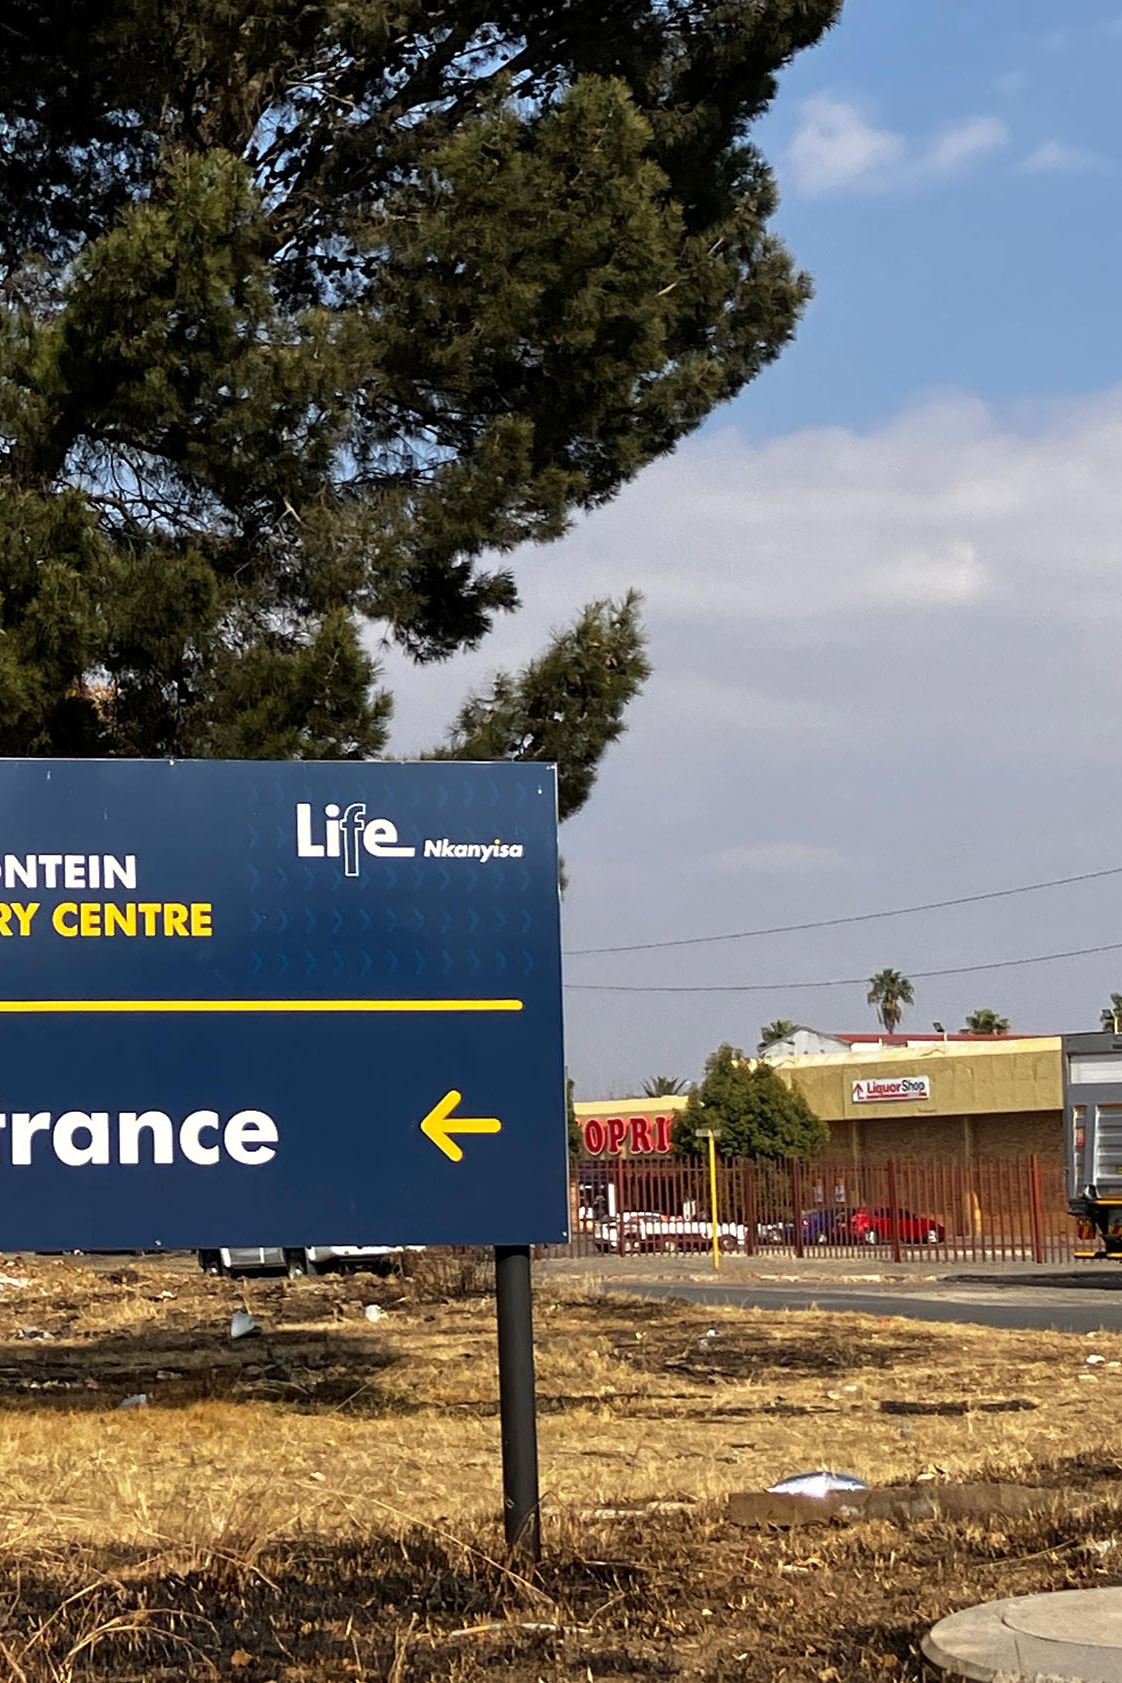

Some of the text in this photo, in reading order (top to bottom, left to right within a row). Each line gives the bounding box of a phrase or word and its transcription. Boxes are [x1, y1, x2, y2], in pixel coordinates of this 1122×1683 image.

[294, 802, 416, 878] Life
[423, 838, 524, 863] Nkanyisa
[51, 902, 213, 938] CENTRE
[575, 1115, 674, 1156] OPRI
